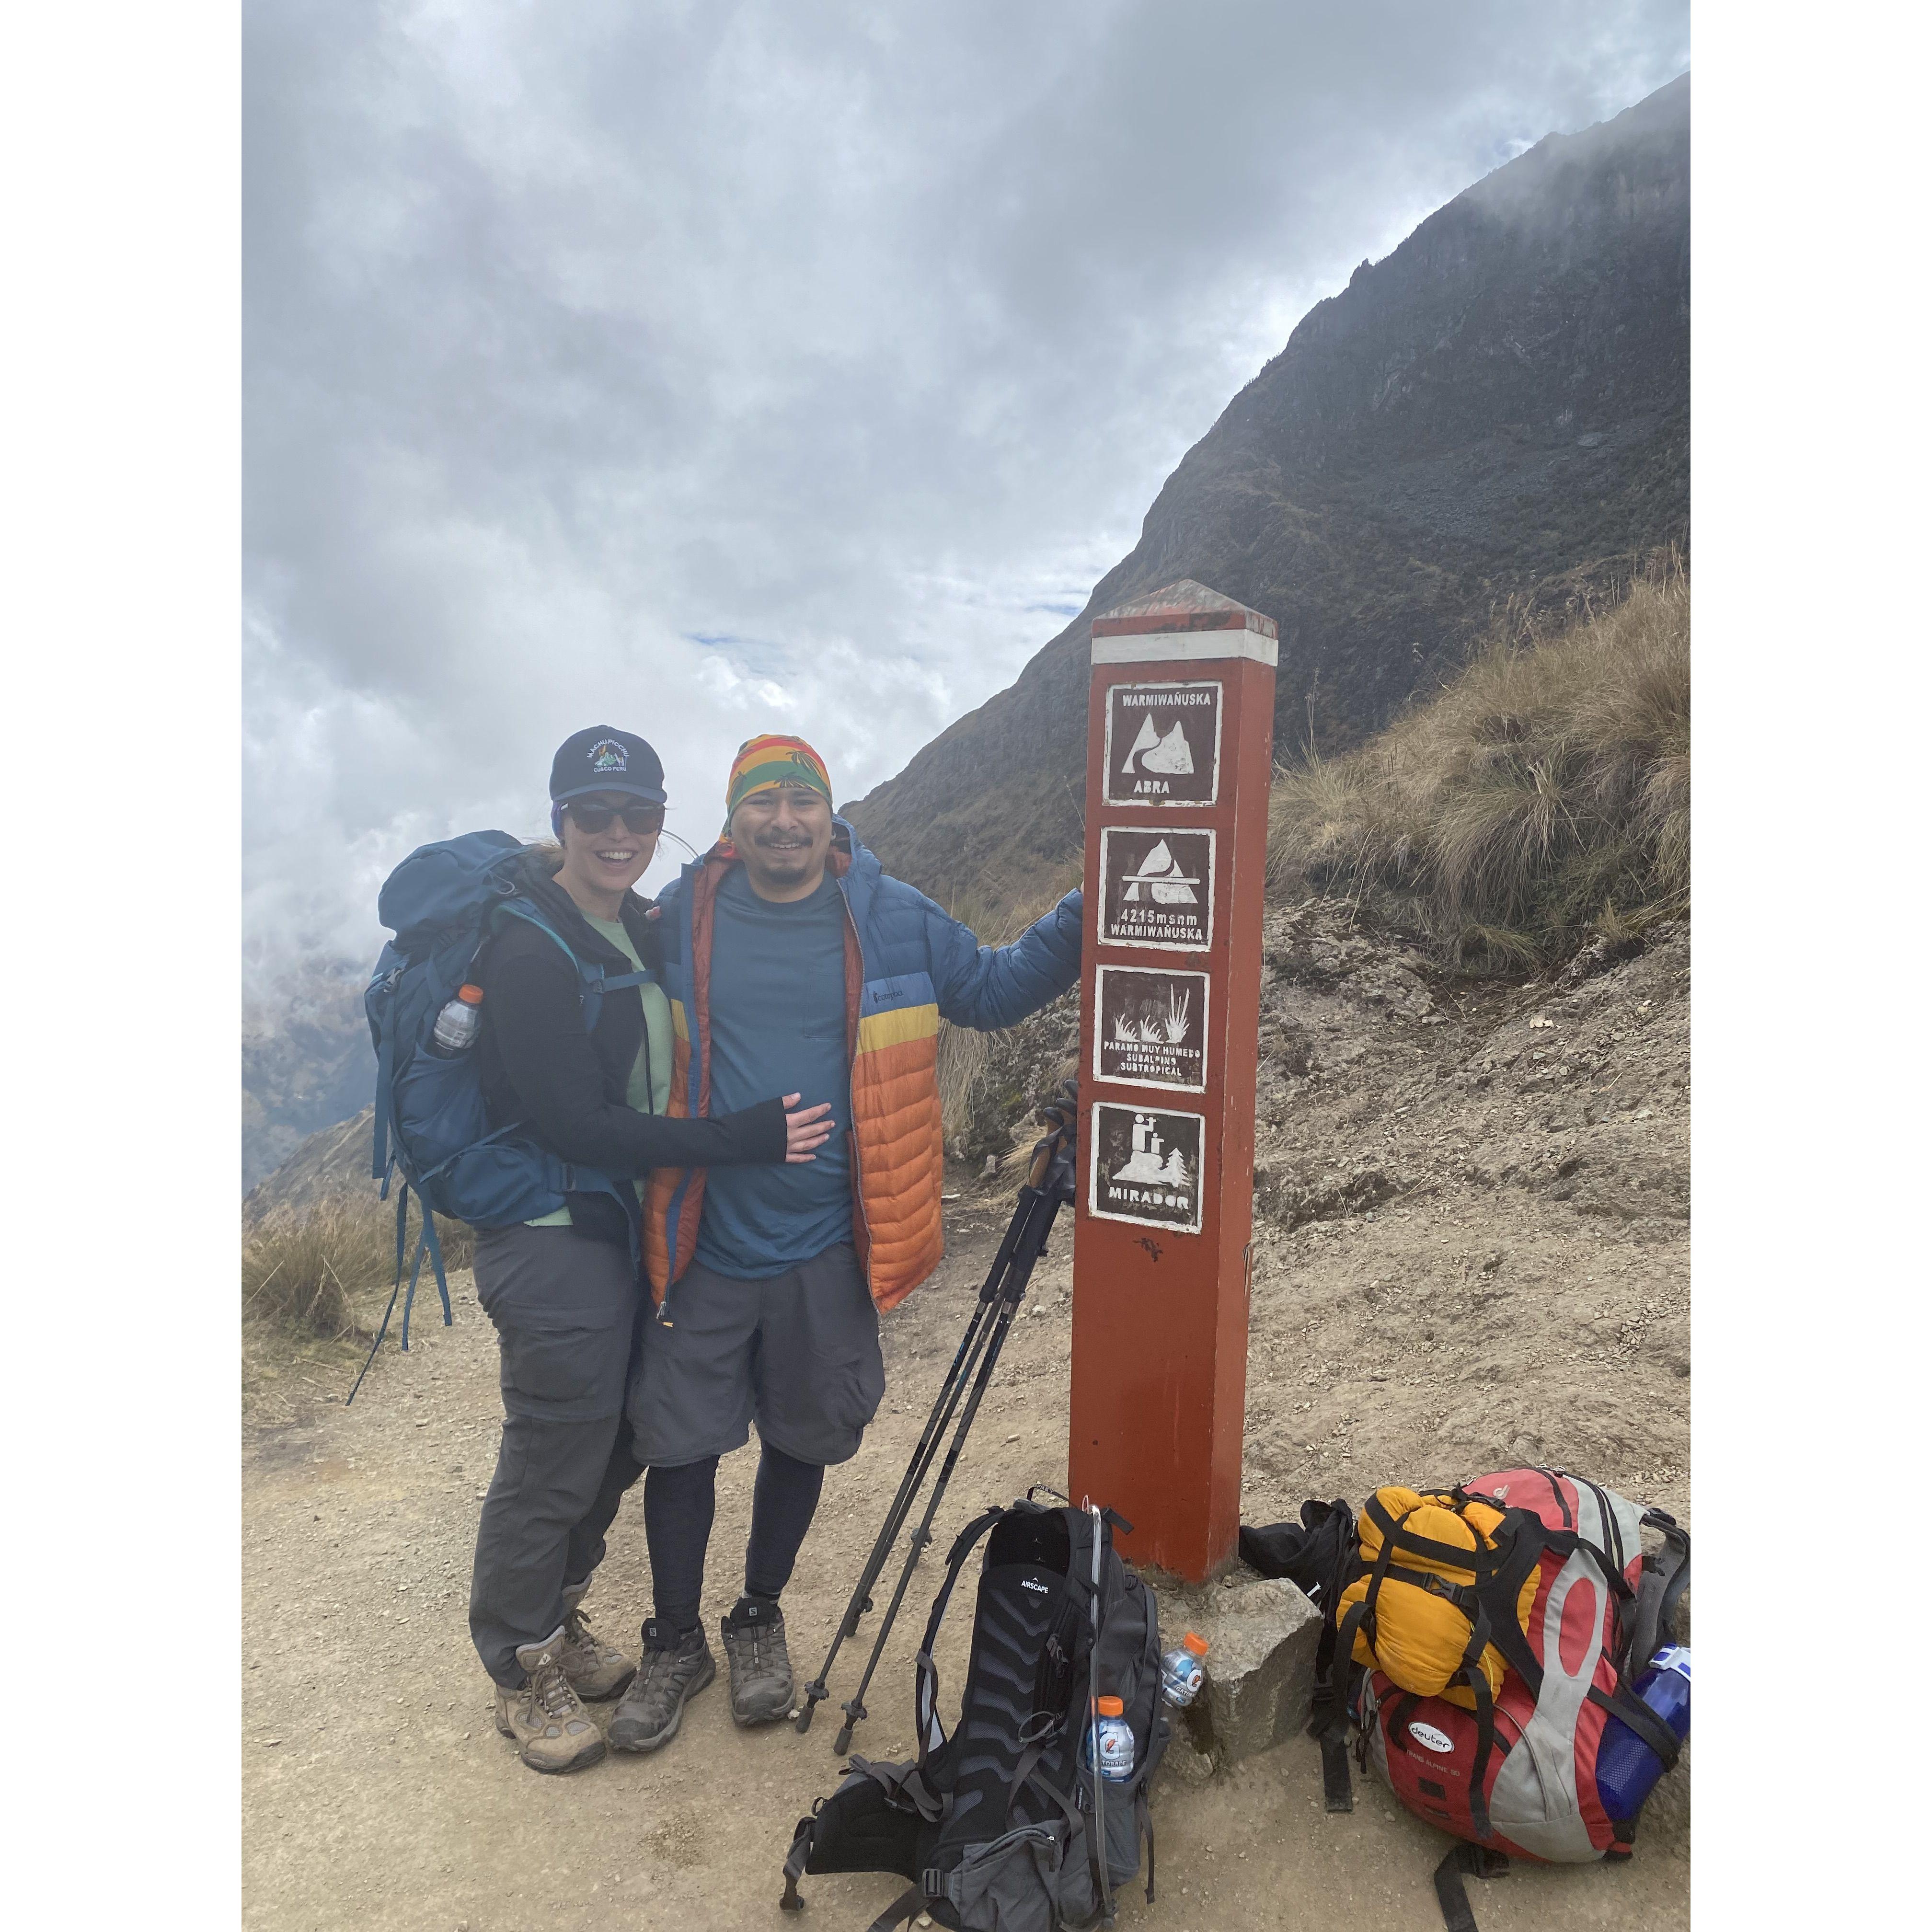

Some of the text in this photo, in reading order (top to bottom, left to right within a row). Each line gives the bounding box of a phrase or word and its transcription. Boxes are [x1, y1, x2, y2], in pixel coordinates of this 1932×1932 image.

[1122, 692, 1211, 707] WARMIWAÑUSKA
[1133, 780, 1170, 794] ABRA
[1111, 924, 1202, 940] WARMIWAÑUSKA
[1104, 1041, 1200, 1058] PARAMO MUY HUMEDO
[1127, 1053, 1176, 1065] SUBALPINO
[1120, 1062, 1182, 1076] SUBTROPICAL
[1109, 1186, 1189, 1209] MIRADOR
[1021, 1580, 1048, 1594] AIRSCAPE
[1411, 1727, 1450, 1748] deuter
[1099, 1732, 1120, 1760] G
[1406, 1749, 1424, 1763] TRANS
[1426, 1760, 1448, 1773] ALPINE
